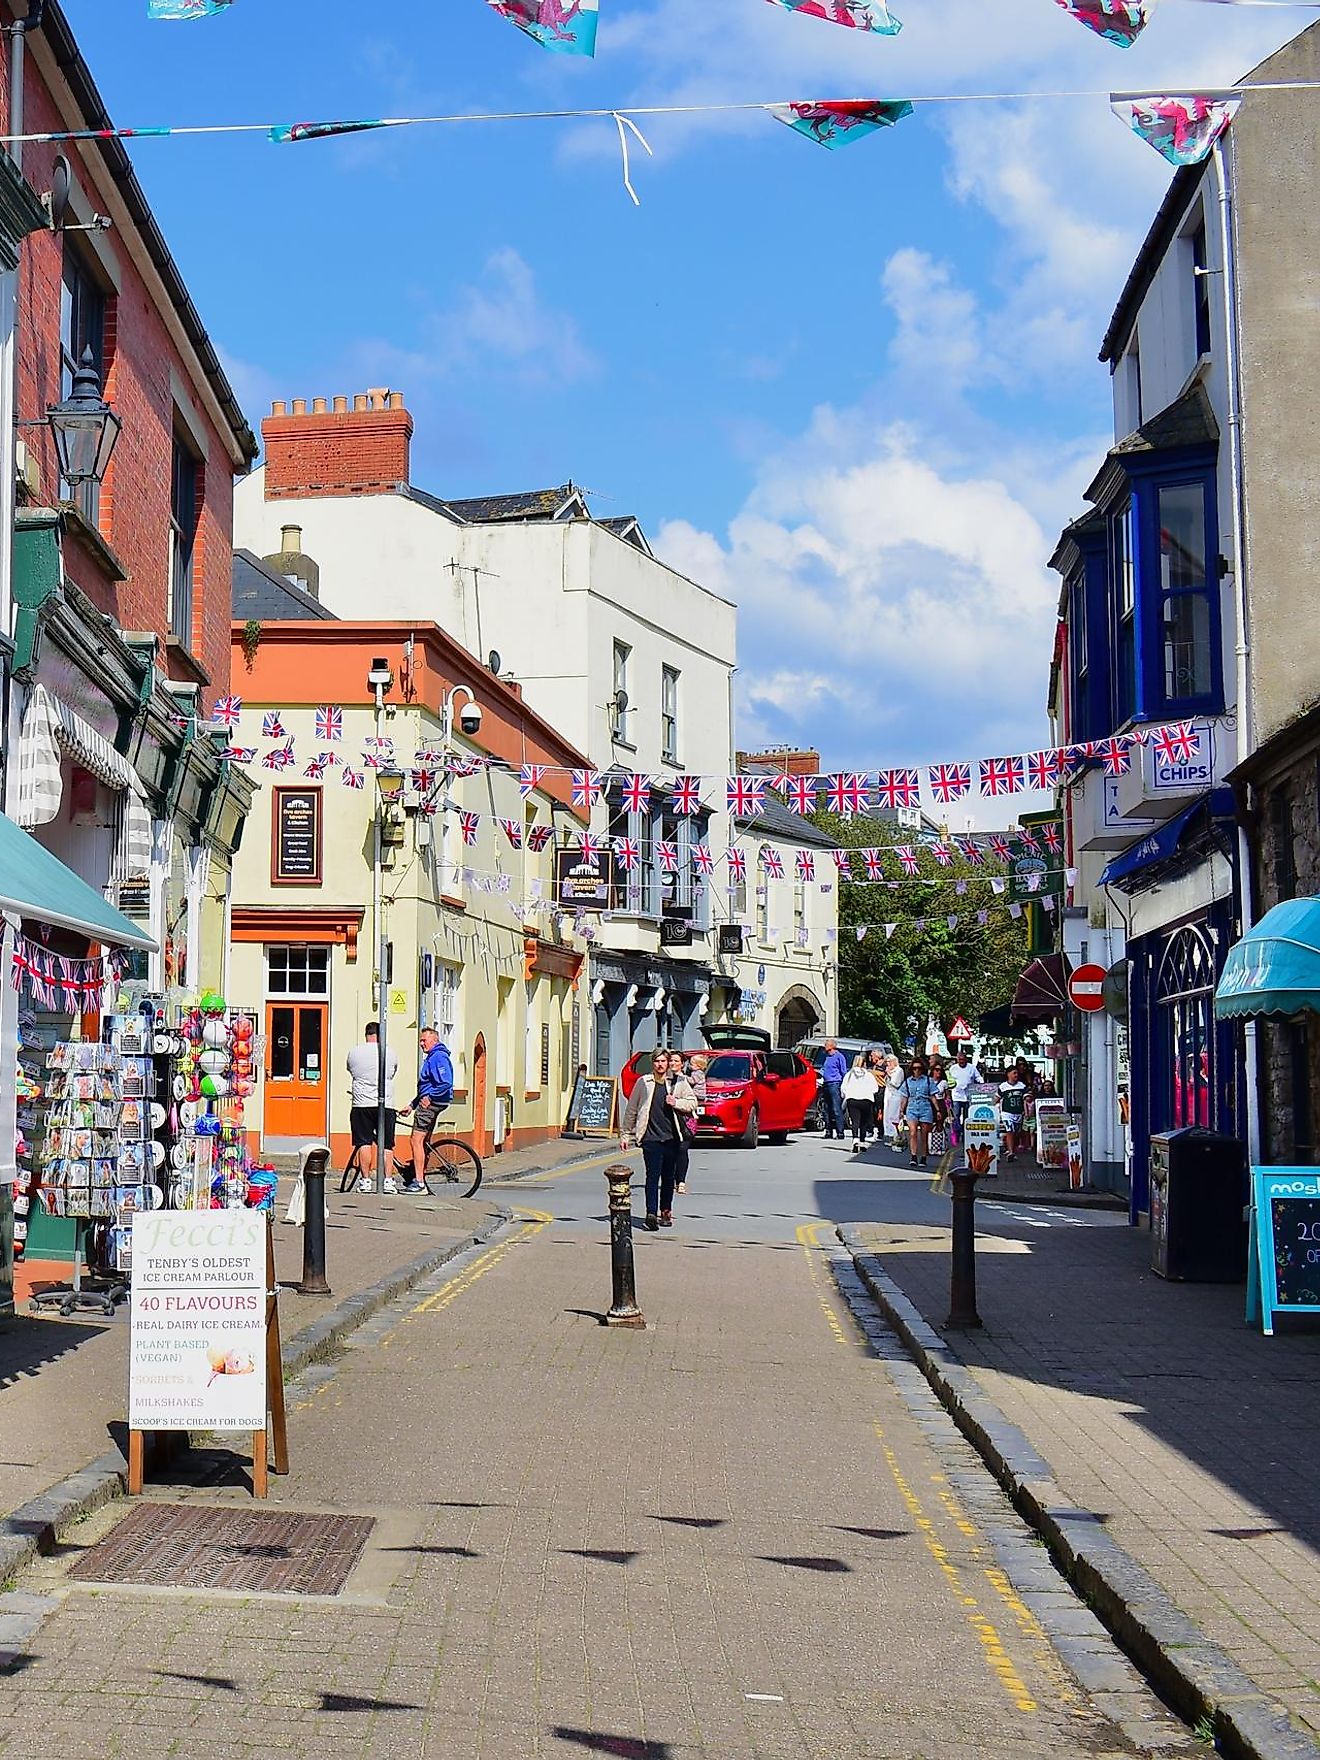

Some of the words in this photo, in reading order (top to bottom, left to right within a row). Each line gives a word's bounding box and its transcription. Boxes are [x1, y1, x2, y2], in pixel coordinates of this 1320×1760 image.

[1160, 765, 1207, 781] CHIPS
[579, 876, 605, 885] arches
[140, 1217, 259, 1254] Fecci's
[147, 1257, 199, 1269] TENBY'S
[202, 1257, 251, 1268] OLDEST
[143, 1273, 160, 1282] ICE
[163, 1272, 201, 1282] CREAM
[204, 1272, 255, 1281] PARLOUR
[139, 1297, 160, 1311] 40
[165, 1295, 258, 1311] FLAVOURS
[136, 1321, 164, 1330] REAL
[167, 1320, 199, 1330] DAIRY
[201, 1320, 219, 1329] ICE
[136, 1340, 172, 1349] PLANT
[174, 1340, 210, 1349] BASED
[135, 1353, 182, 1363] (VEGAN)
[135, 1375, 185, 1385] SORBETS
[135, 1398, 204, 1407] MILKSHAKES
[170, 1418, 186, 1426] ICE
[186, 1418, 217, 1426] CREAM
[219, 1418, 236, 1426] FOR
[238, 1418, 263, 1426] DOGS
